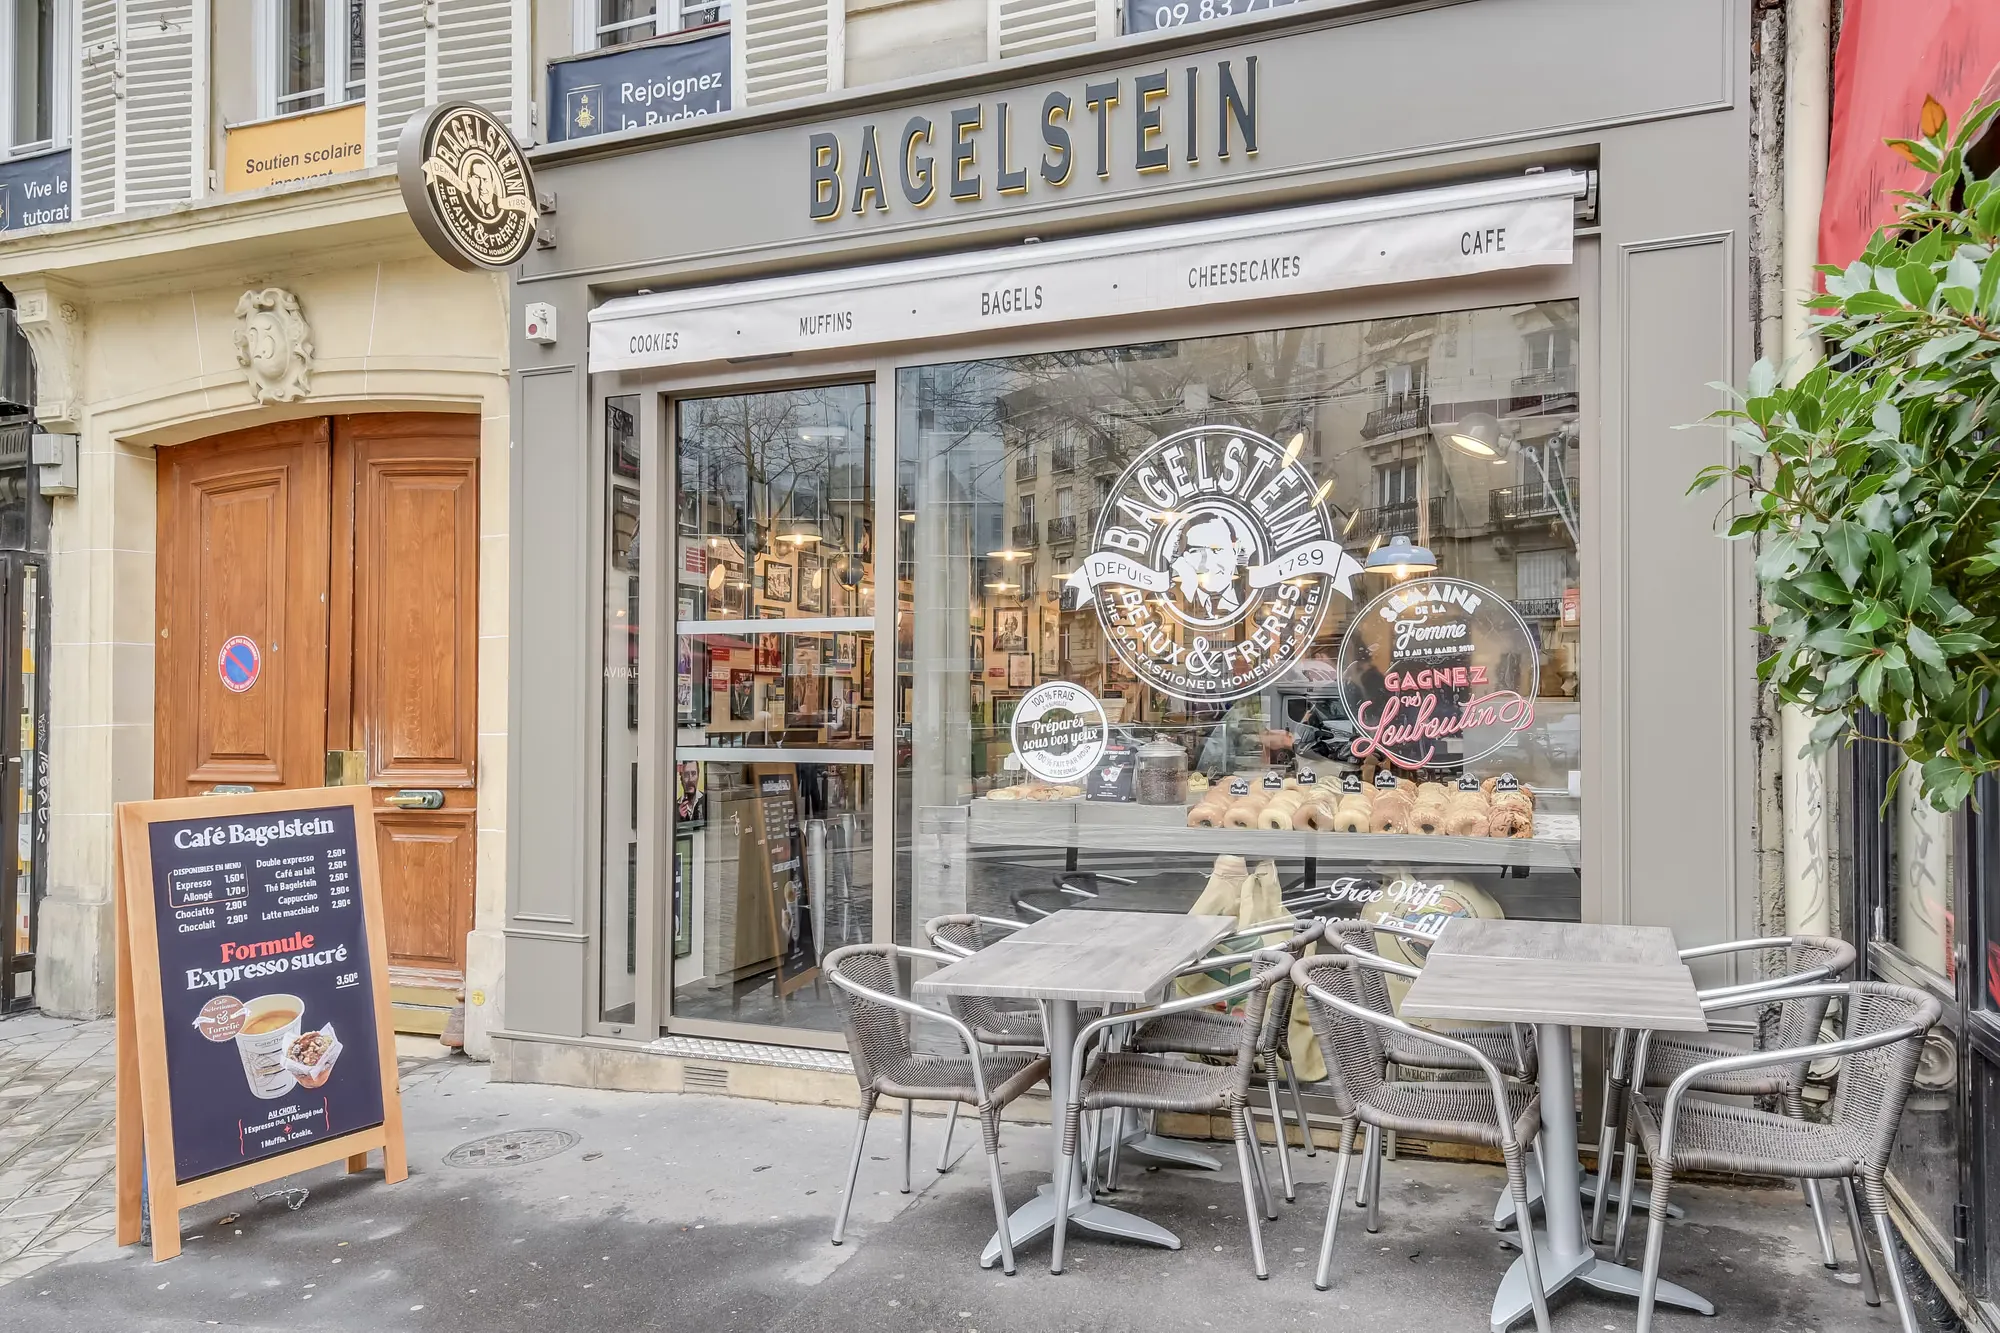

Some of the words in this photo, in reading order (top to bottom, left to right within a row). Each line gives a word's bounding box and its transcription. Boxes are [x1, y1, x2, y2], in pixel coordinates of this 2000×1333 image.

[1155, 3, 1189, 30] 09
[1199, 0, 1233, 21] 83
[621, 72, 722, 106] Rejoignez
[808, 55, 1260, 222] BAGELSTEIN
[245, 154, 299, 174] Soutien
[304, 142, 362, 164] scolaire
[437, 115, 525, 195] BAGELSTEIN
[24, 181, 52, 200] Vive
[56, 175, 68, 194] le
[23, 204, 69, 226] tutorat
[438, 182, 447, 201] THE
[514, 217, 526, 242] BAGEL
[446, 185, 475, 237] BEAUX
[474, 222, 490, 249] &
[629, 332, 680, 355] COOKIES
[799, 311, 853, 337] MUFFINS
[981, 285, 1044, 316] BAGELS
[1188, 256, 1301, 290] CHEESECAKES
[1461, 228, 1507, 257] CAFE
[1102, 436, 1322, 556] BAGELSTEIN
[1094, 561, 1153, 586] DEPUIS
[1278, 549, 1324, 577] 1789
[1380, 584, 1482, 623] SEMAINE
[1415, 605, 1428, 615] DE
[1431, 603, 1446, 613] LA
[1104, 594, 1120, 621] THE
[1115, 625, 1217, 690] OLD-FASHIONED
[1221, 640, 1298, 690] HOMEMADE
[1295, 586, 1321, 637] BAGEL
[1121, 589, 1187, 667] BEAUX
[1185, 636, 1222, 678] &
[1394, 615, 1467, 651] Femme
[1434, 645, 1458, 654] MARS
[1384, 666, 1489, 692] GAGNEZ
[1031, 694, 1045, 708] 100
[1053, 690, 1075, 702] FRAIS
[1031, 714, 1084, 736] Préparés
[1351, 690, 1535, 770] Louboutin
[1022, 737, 1048, 751] sous
[1050, 734, 1069, 746] vos
[1070, 729, 1098, 747] yeux
[174, 825, 226, 849] Café
[228, 817, 334, 846] Bagelstein
[173, 864, 214, 876] DISPONIBLES
[215, 863, 223, 871] EN
[224, 862, 241, 870] MENU
[256, 858, 281, 868] Double
[282, 855, 314, 866] expresso
[275, 869, 293, 879] Café
[294, 869, 303, 877] au
[303, 866, 315, 875] lait
[176, 880, 212, 891] Expresso
[183, 890, 213, 902] Allongé
[264, 882, 278, 892] Thé
[280, 879, 317, 891] Bagelstein
[1327, 877, 1384, 903] Free
[1387, 880, 1445, 912] Wifi
[278, 892, 318, 905] Cappuccino
[175, 906, 214, 919] Chociatto
[262, 910, 282, 920] Latte
[283, 905, 319, 917] macchiato
[178, 920, 216, 933] Chocolait
[220, 931, 315, 963] Formule
[185, 957, 289, 991] Expresso
[291, 944, 348, 968] sucré
[216, 1010, 229, 1025] &
[248, 1121, 274, 1133] Expresso
[291, 1110, 312, 1122] Allongé
[268, 1109, 278, 1119] AU
[278, 1105, 297, 1115] CHOIX
